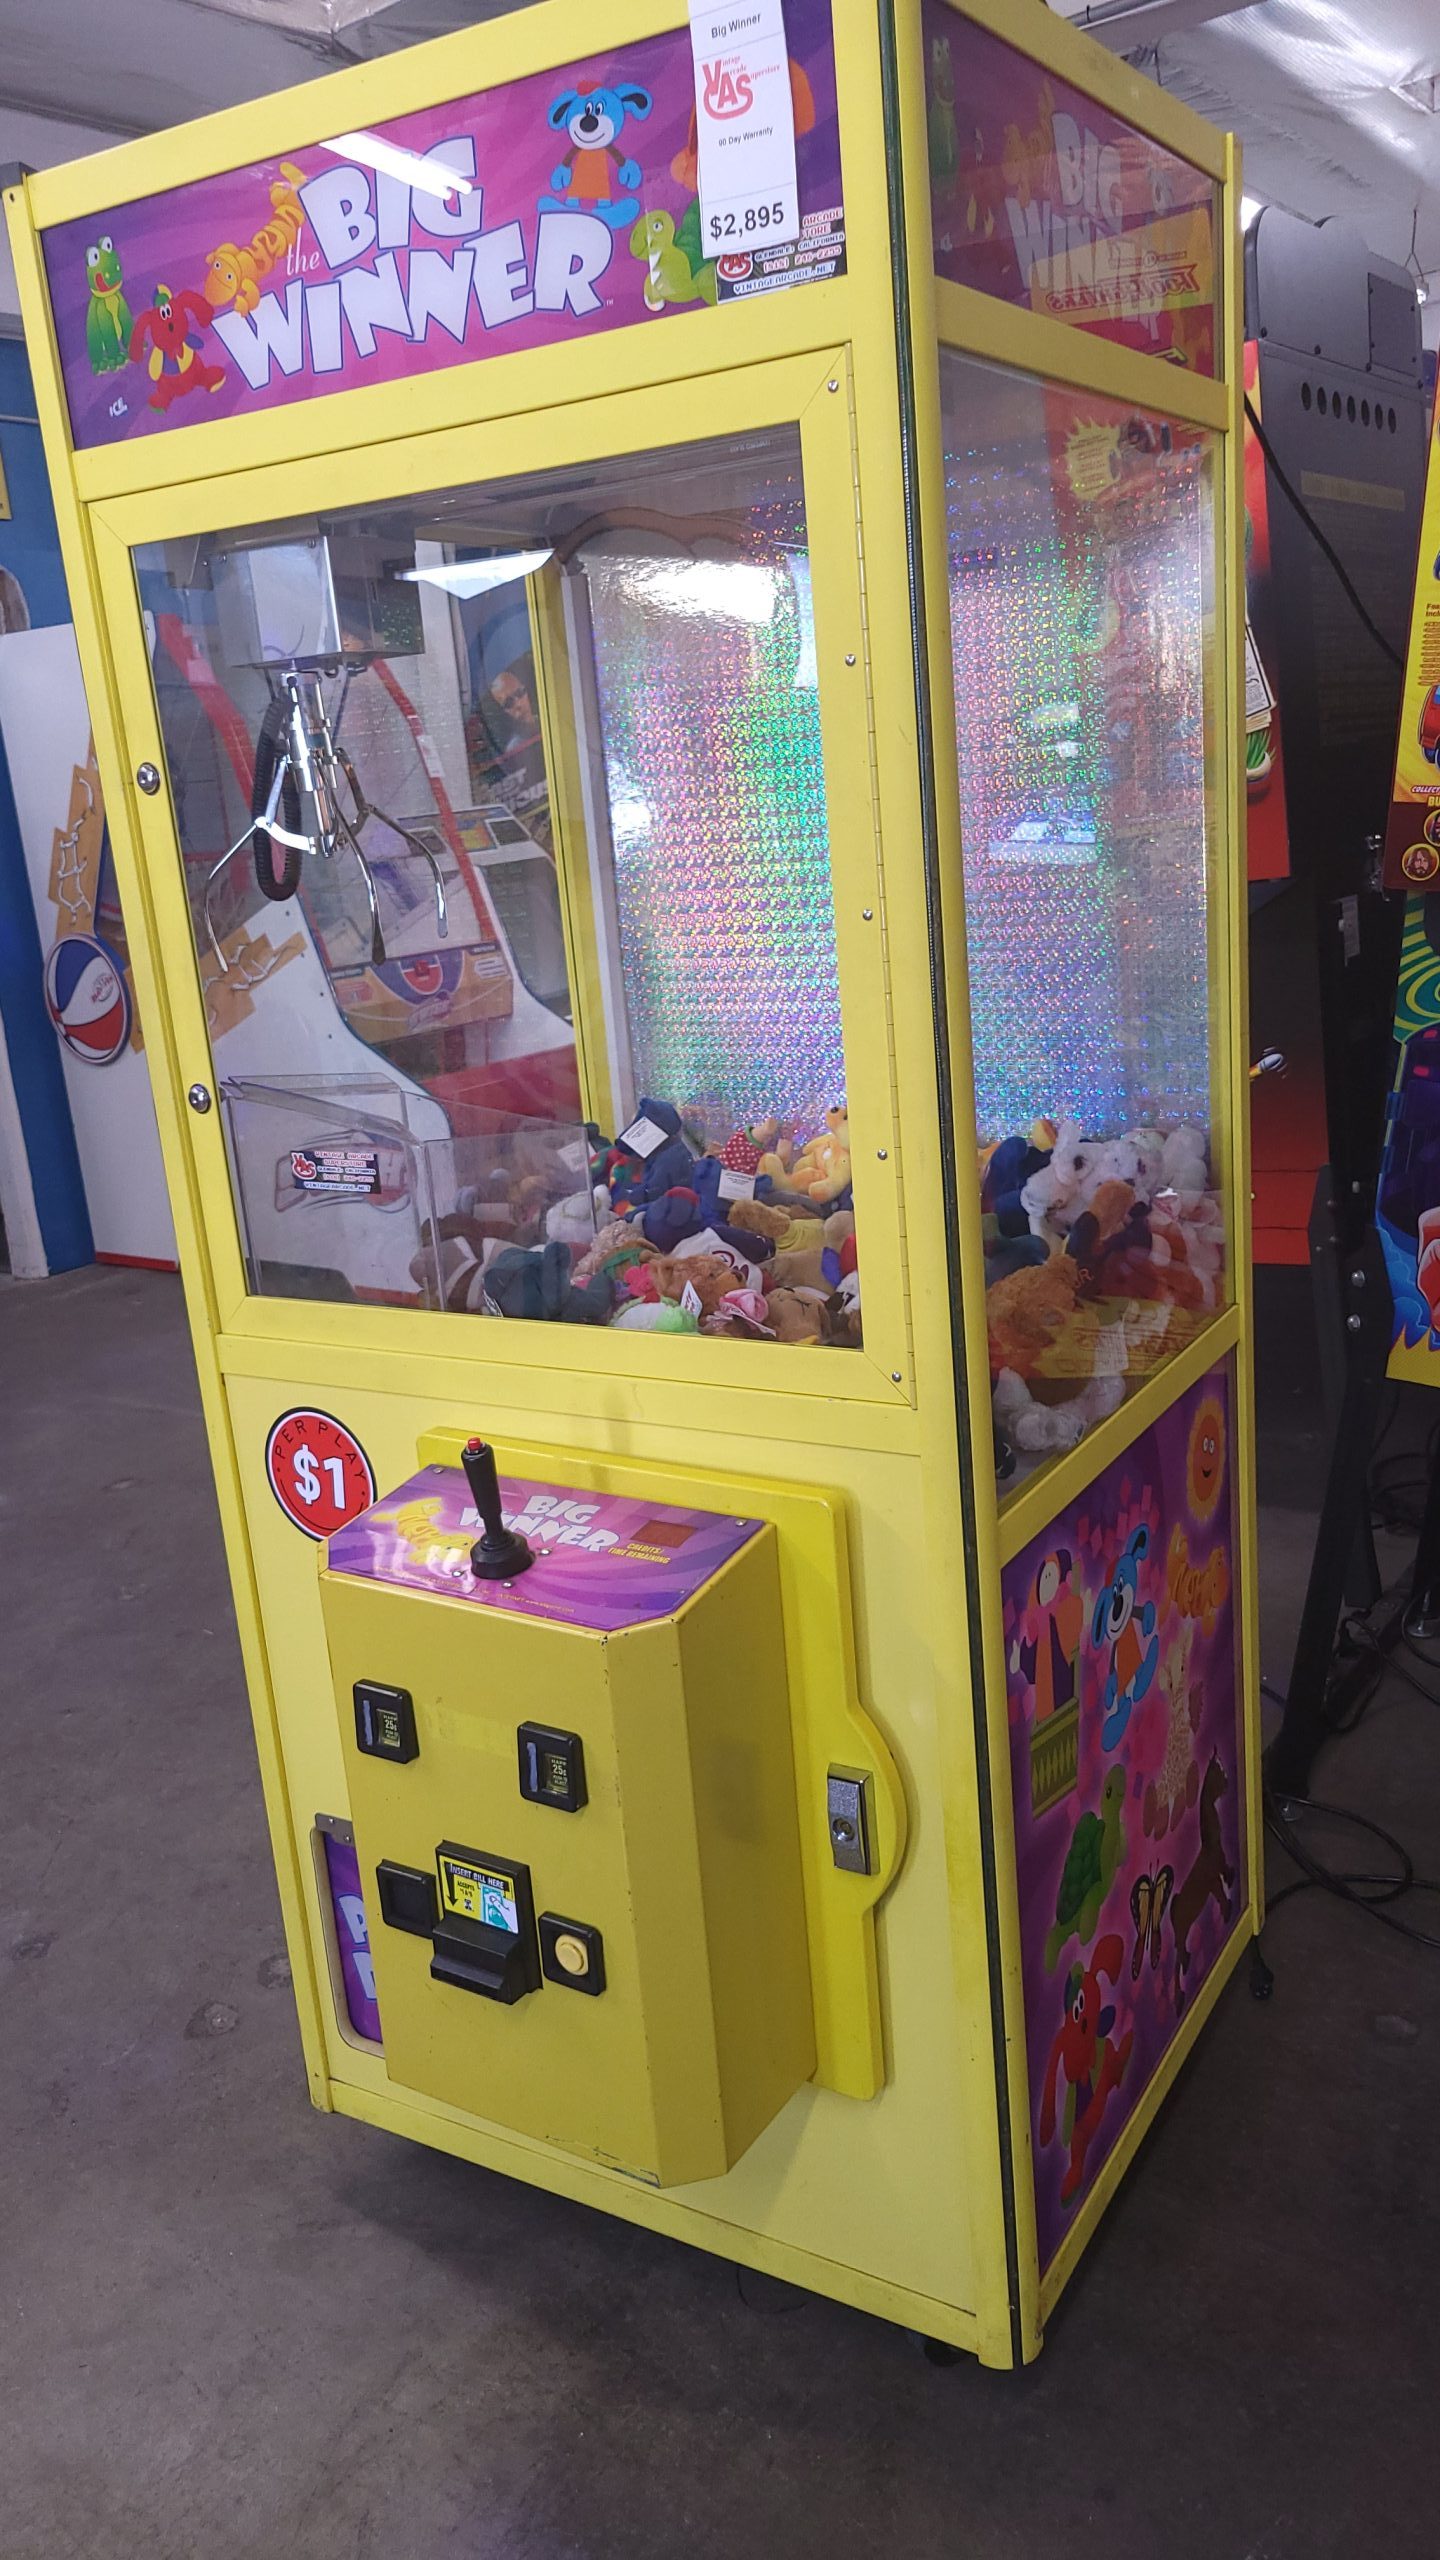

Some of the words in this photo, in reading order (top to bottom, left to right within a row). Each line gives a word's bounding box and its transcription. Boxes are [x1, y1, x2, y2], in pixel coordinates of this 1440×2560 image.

[711, 26, 727, 39] Big
[728, 13, 761, 33] Winner
[718, 138, 727, 147] 90
[728, 135, 742, 146] Day
[743, 126, 774, 141] Warranty
[1052, 113, 1123, 235] BIG
[297, 135, 485, 270] BIG
[802, 208, 842, 227] ARCADE
[710, 201, 784, 241] $2,895
[801, 223, 831, 240] TORE
[286, 227, 320, 276] the
[733, 261, 836, 294] VINTAGEARCADE.NET
[211, 212, 613, 391] WINNER
[275, 1419, 307, 1459] PER
[318, 1421, 367, 1481] PLAY
[293, 1443, 346, 1510] $1
[523, 1495, 601, 1525] BIG
[460, 1507, 621, 1552] WNNER
[626, 1550, 671, 1564] REMAINING
[450, 1863, 471, 1878] INSERT
[473, 1872, 486, 1884] BILL
[488, 1877, 504, 1889] HERE
